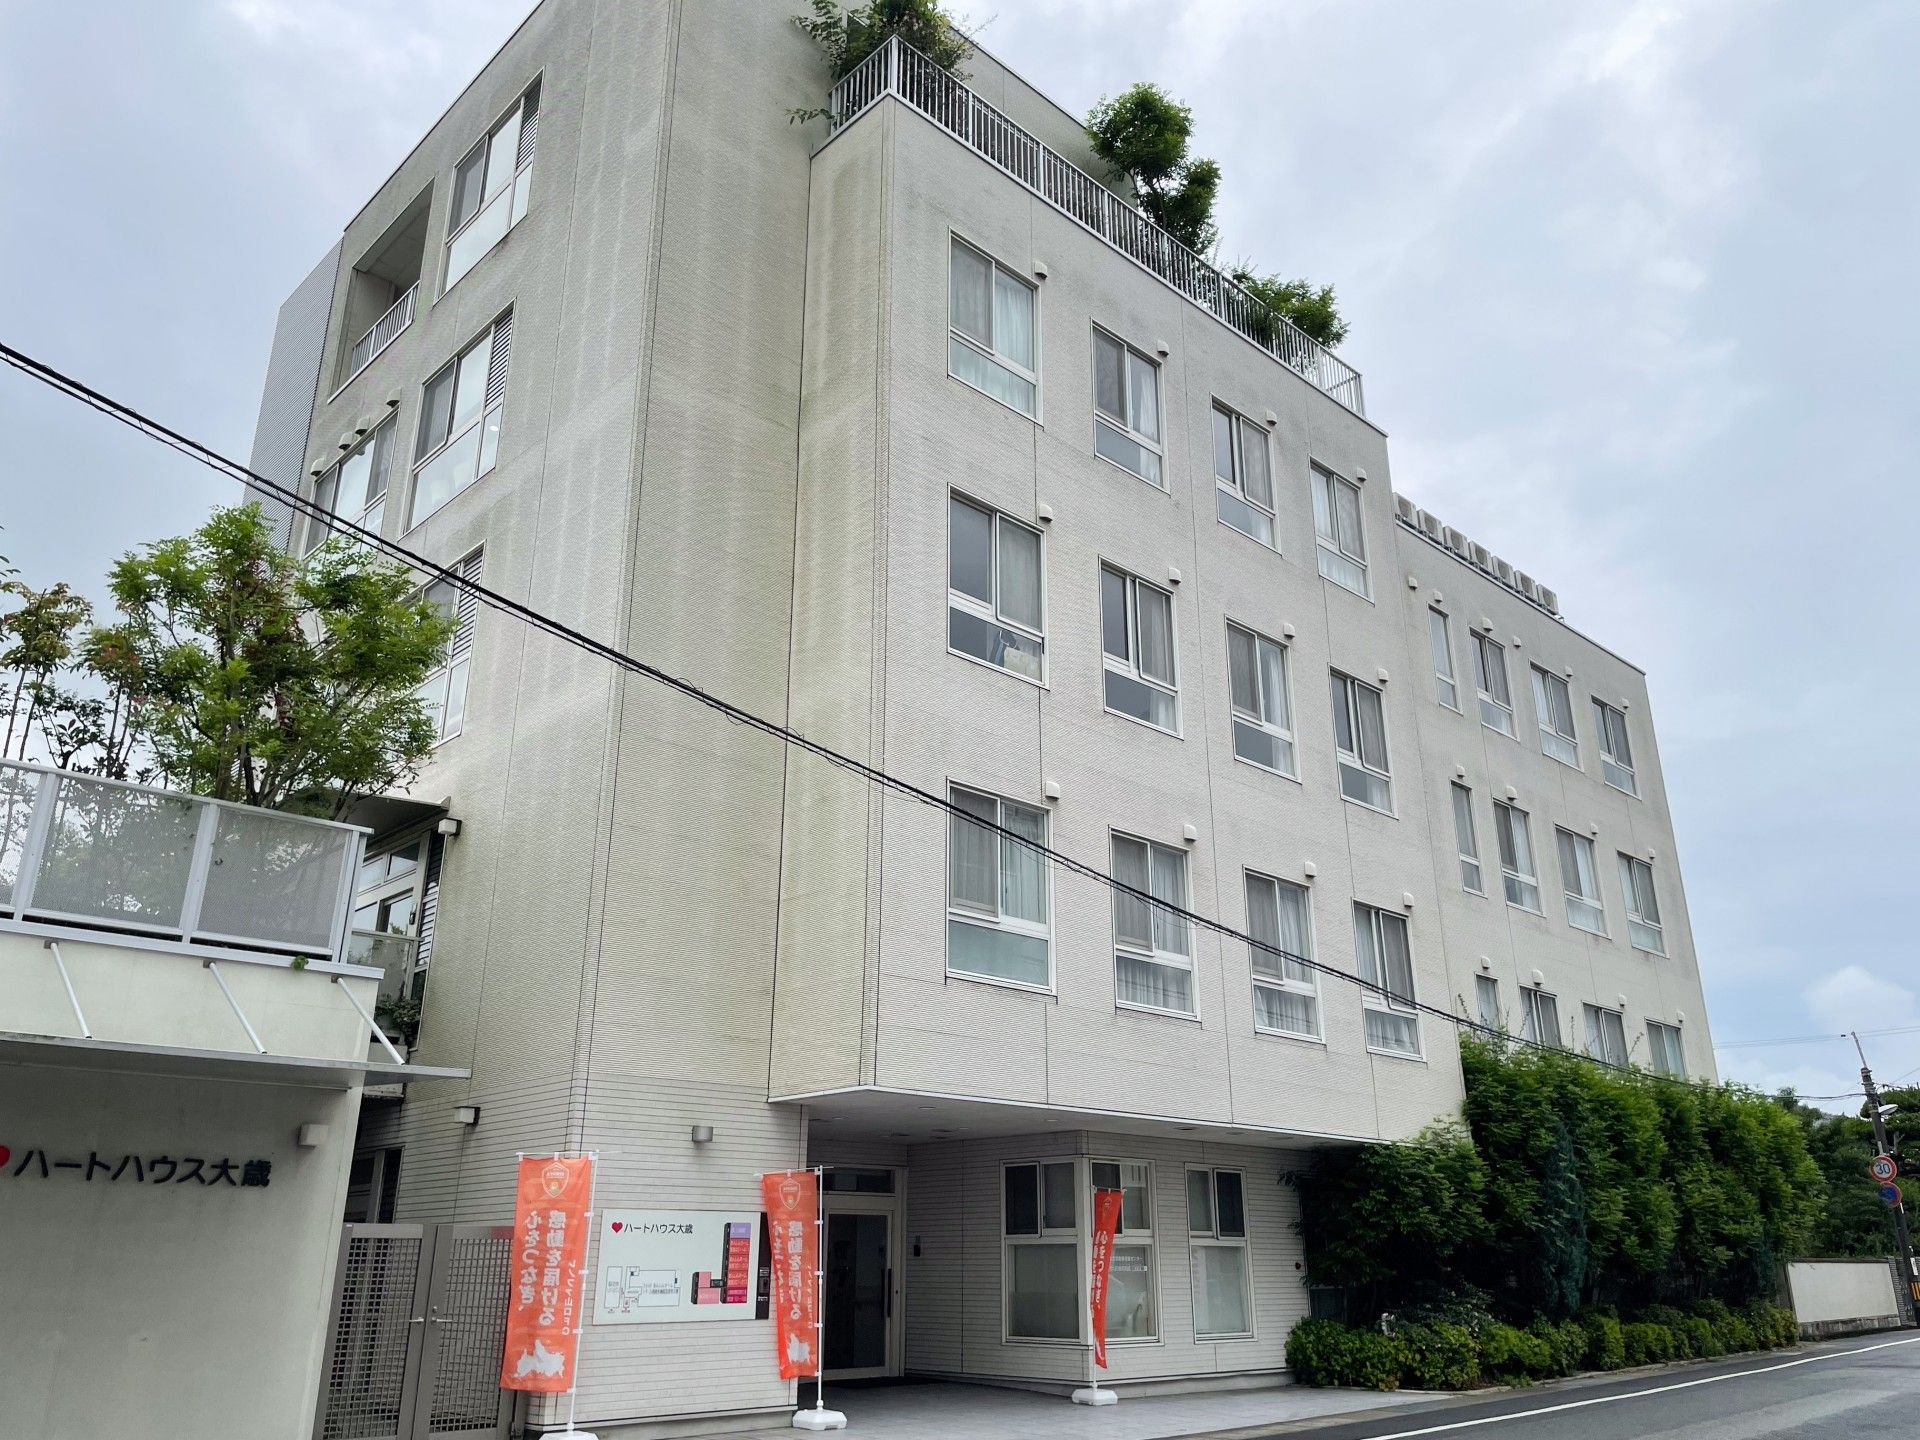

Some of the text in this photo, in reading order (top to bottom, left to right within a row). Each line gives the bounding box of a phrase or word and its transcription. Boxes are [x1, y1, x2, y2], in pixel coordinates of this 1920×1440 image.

[14, 1150, 272, 1187] ハートハウス大歳
[1875, 1163, 1891, 1175] 30
[624, 1223, 694, 1235] ハートハウス大歳
